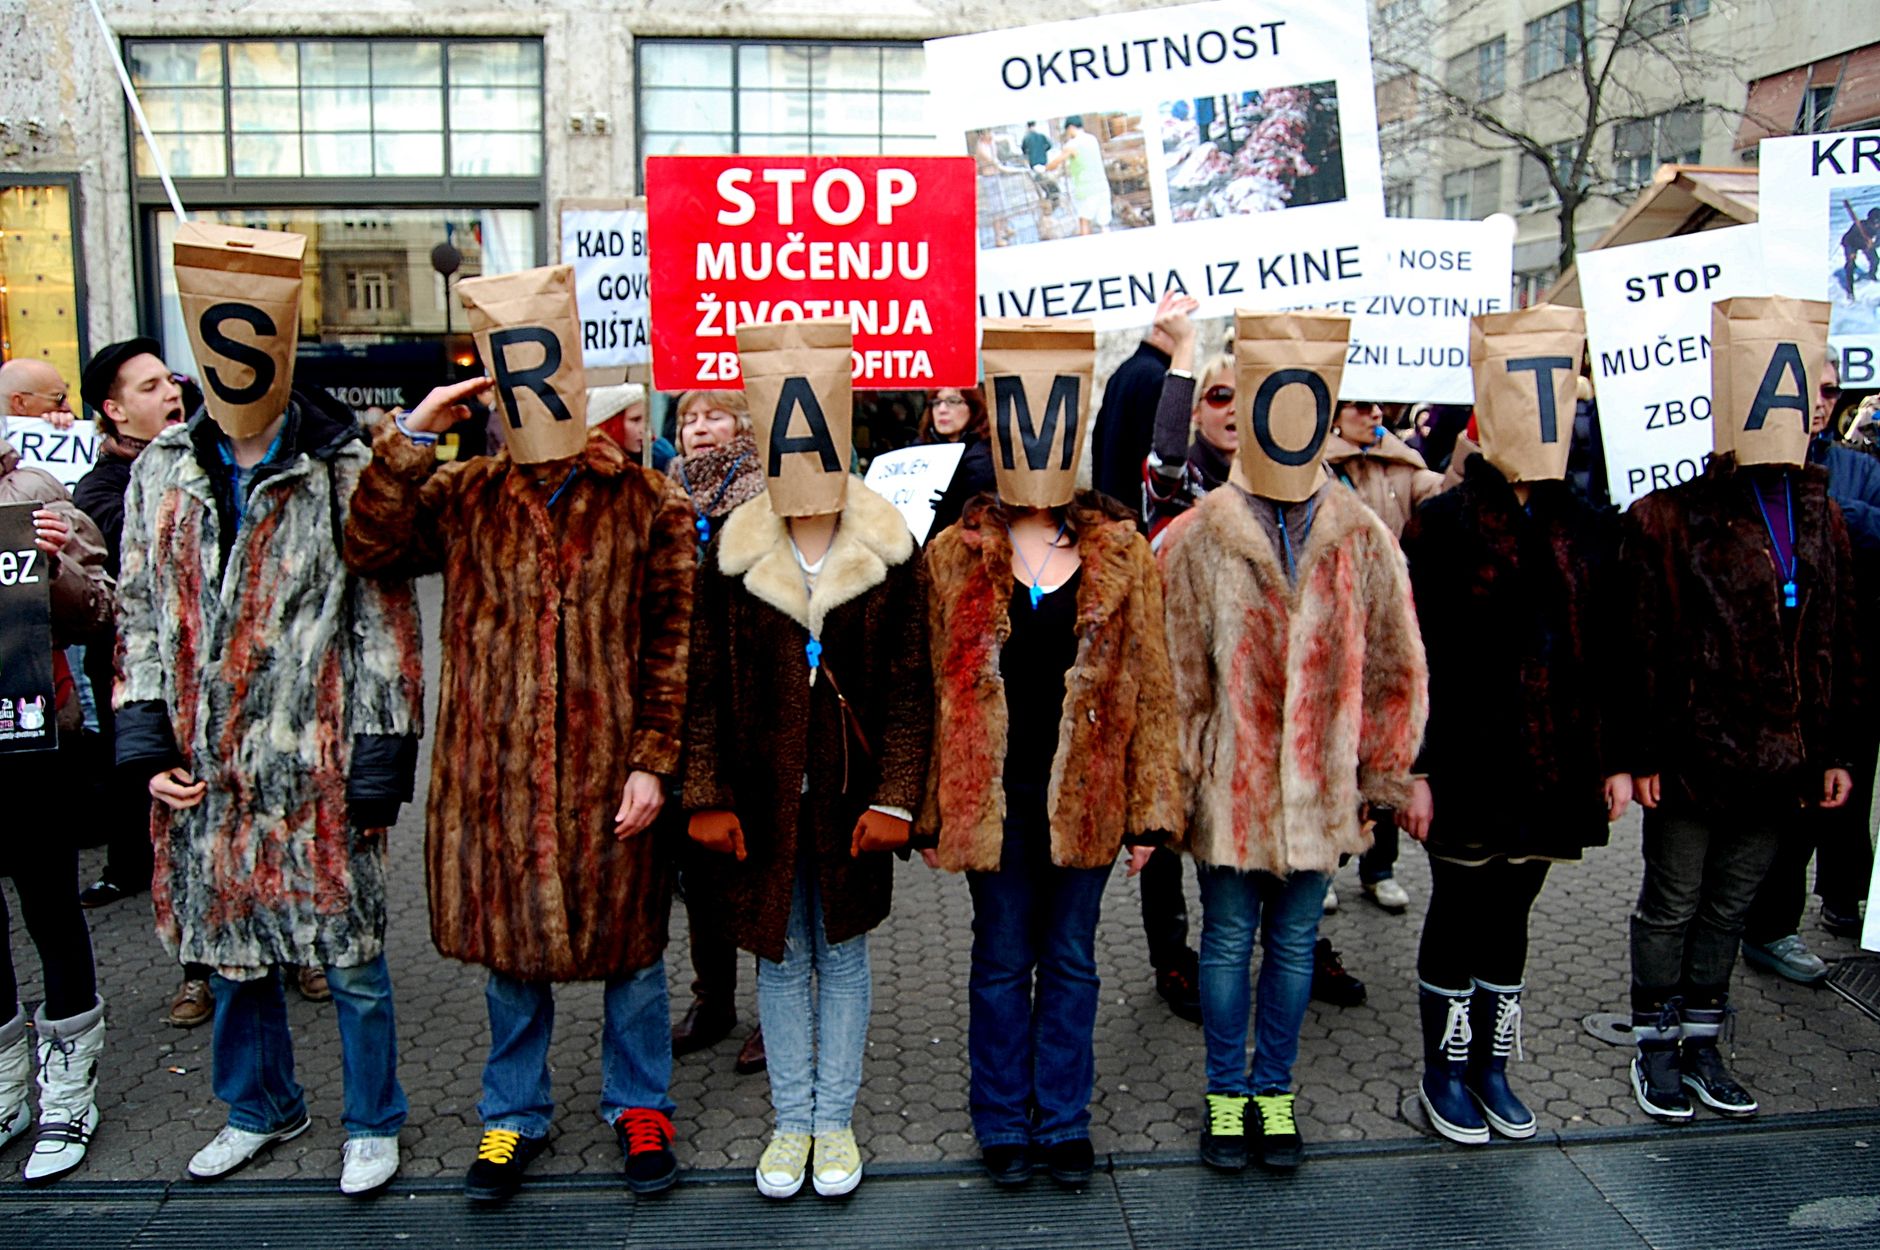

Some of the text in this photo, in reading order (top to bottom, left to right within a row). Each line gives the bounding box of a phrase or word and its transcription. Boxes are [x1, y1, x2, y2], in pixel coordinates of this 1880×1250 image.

[1001, 21, 1286, 90] OKRUTNOST
[1811, 136, 1880, 177] KR
[716, 167, 918, 226] STOP
[577, 230, 624, 257] KAD
[696, 232, 930, 281] MUČENJU
[1399, 249, 1472, 271] NOSE
[598, 273, 649, 300] GOV
[1205, 261, 1245, 297] IZ
[1258, 245, 1362, 290] KINE
[1626, 263, 1721, 302] STOP
[199, 303, 277, 405] S
[489, 326, 573, 430] R
[695, 350, 934, 381] ZB OFITA
[1602, 334, 1712, 378] MUČEN
[1506, 357, 1573, 444] T
[1644, 395, 1712, 431] ZBO
[1743, 342, 1810, 435] A
[768, 376, 842, 478] A
[992, 374, 1080, 472] M
[1252, 369, 1334, 467] O
